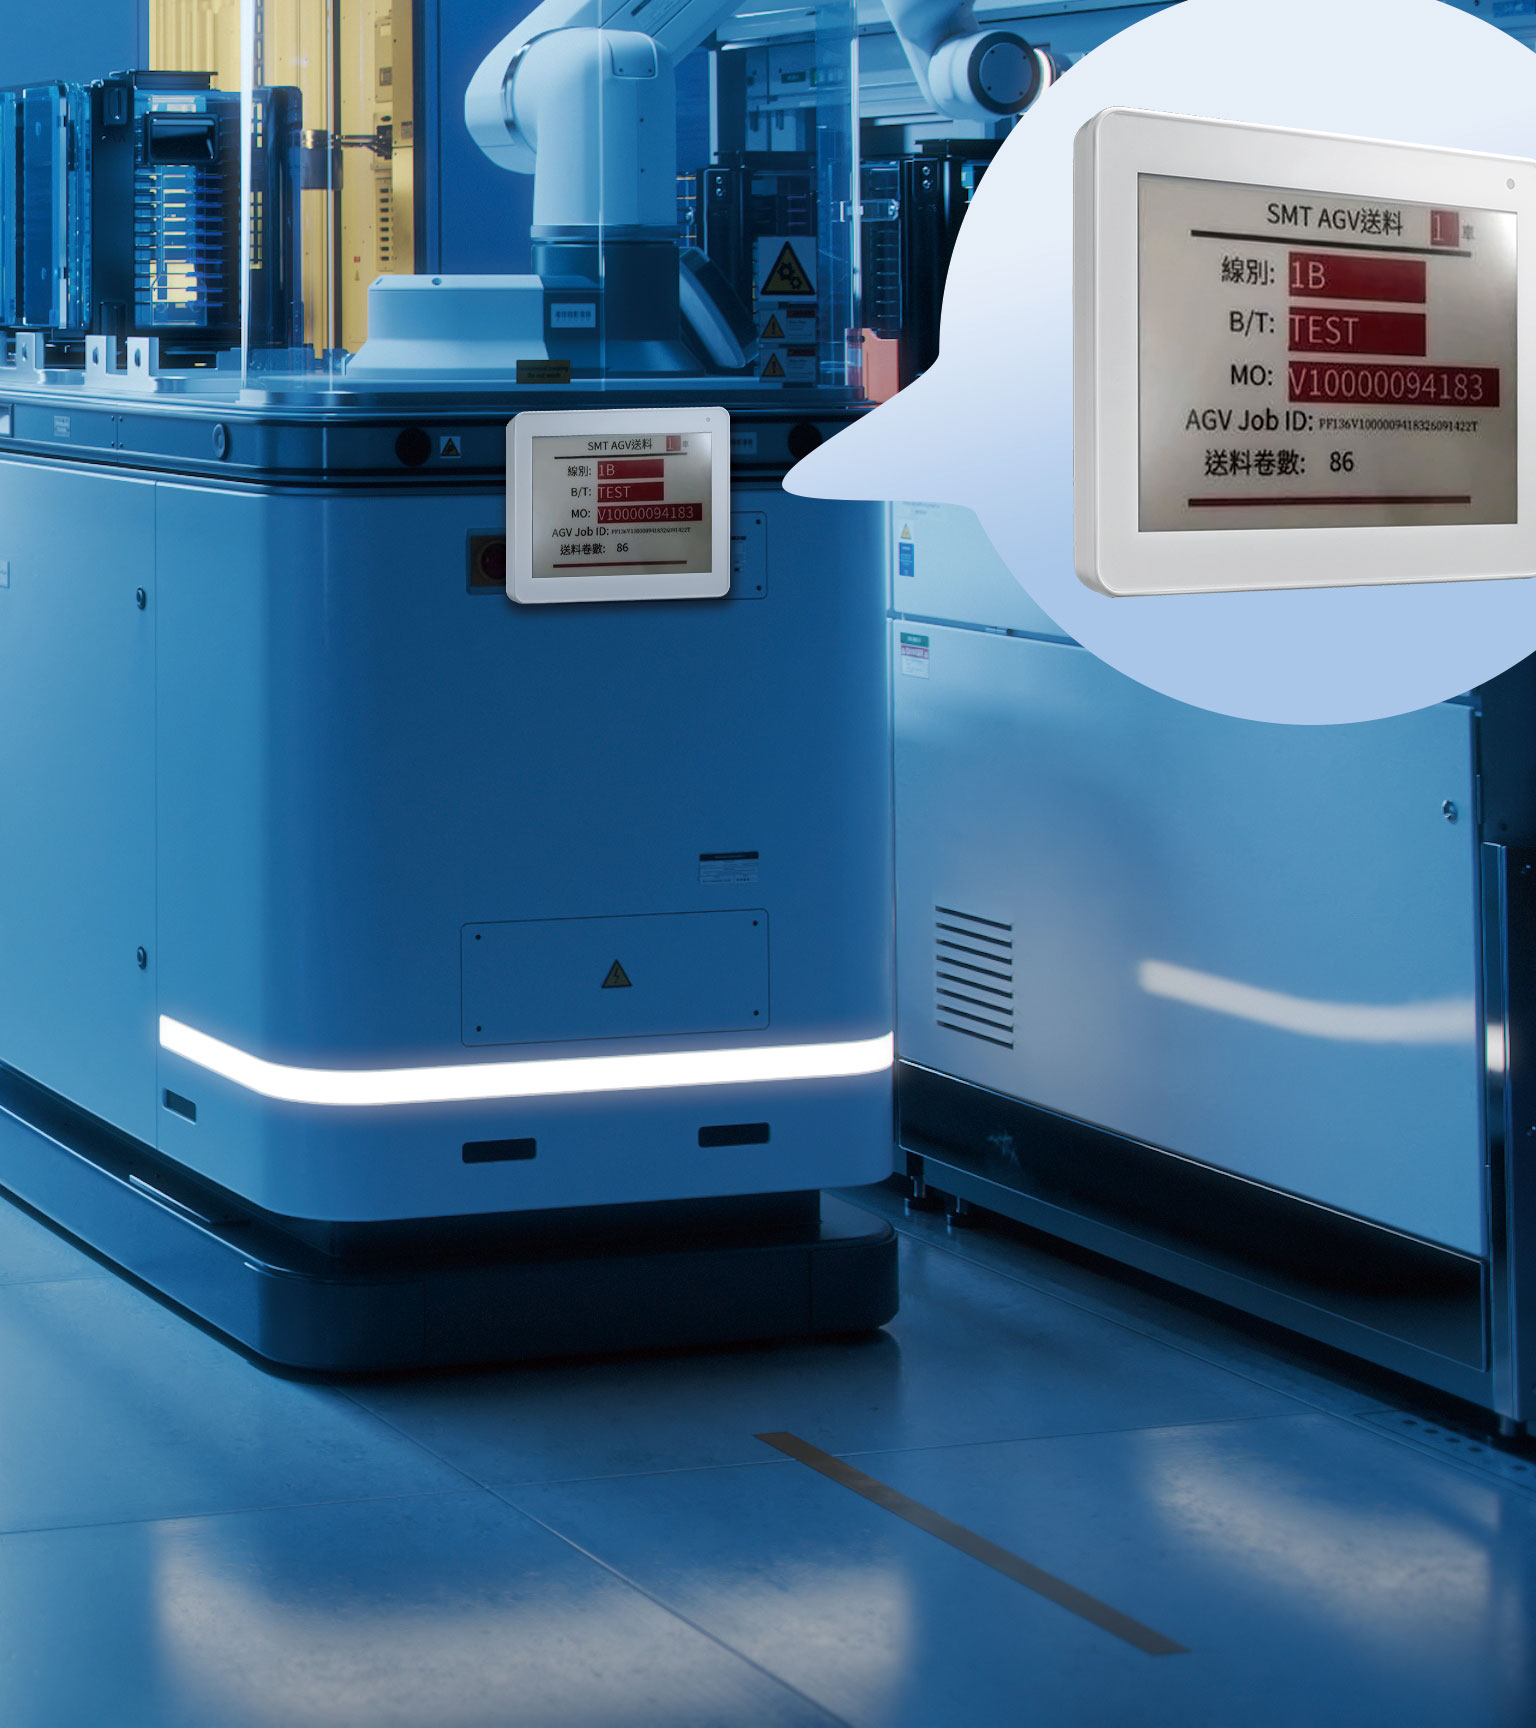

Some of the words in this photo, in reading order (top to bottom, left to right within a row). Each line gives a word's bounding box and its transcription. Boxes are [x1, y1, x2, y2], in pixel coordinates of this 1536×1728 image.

[1267, 203, 1313, 227] SMT
[1317, 207, 1403, 237] AGV送料
[1433, 214, 1444, 241] 1
[1221, 255, 1275, 286] 線別:
[1292, 260, 1326, 290] 1B
[1229, 310, 1275, 337] B/T:
[1289, 314, 1360, 345] TEST
[1230, 364, 1274, 387] MO:
[1289, 368, 1484, 401] V10000094183
[1185, 408, 1233, 432] AGV
[1238, 408, 1279, 432] Job
[1285, 410, 1314, 432] ID:
[588, 441, 608, 451] SMT
[599, 463, 615, 477] 1B
[1330, 451, 1355, 473] 86
[571, 487, 592, 498] B/T:
[598, 485, 631, 499] TEST
[571, 509, 591, 518] MO:
[598, 506, 694, 521] V10000094183
[551, 528, 573, 538] AGV
[574, 526, 594, 537] Job
[596, 527, 610, 536] ID:
[616, 542, 629, 553] 86
